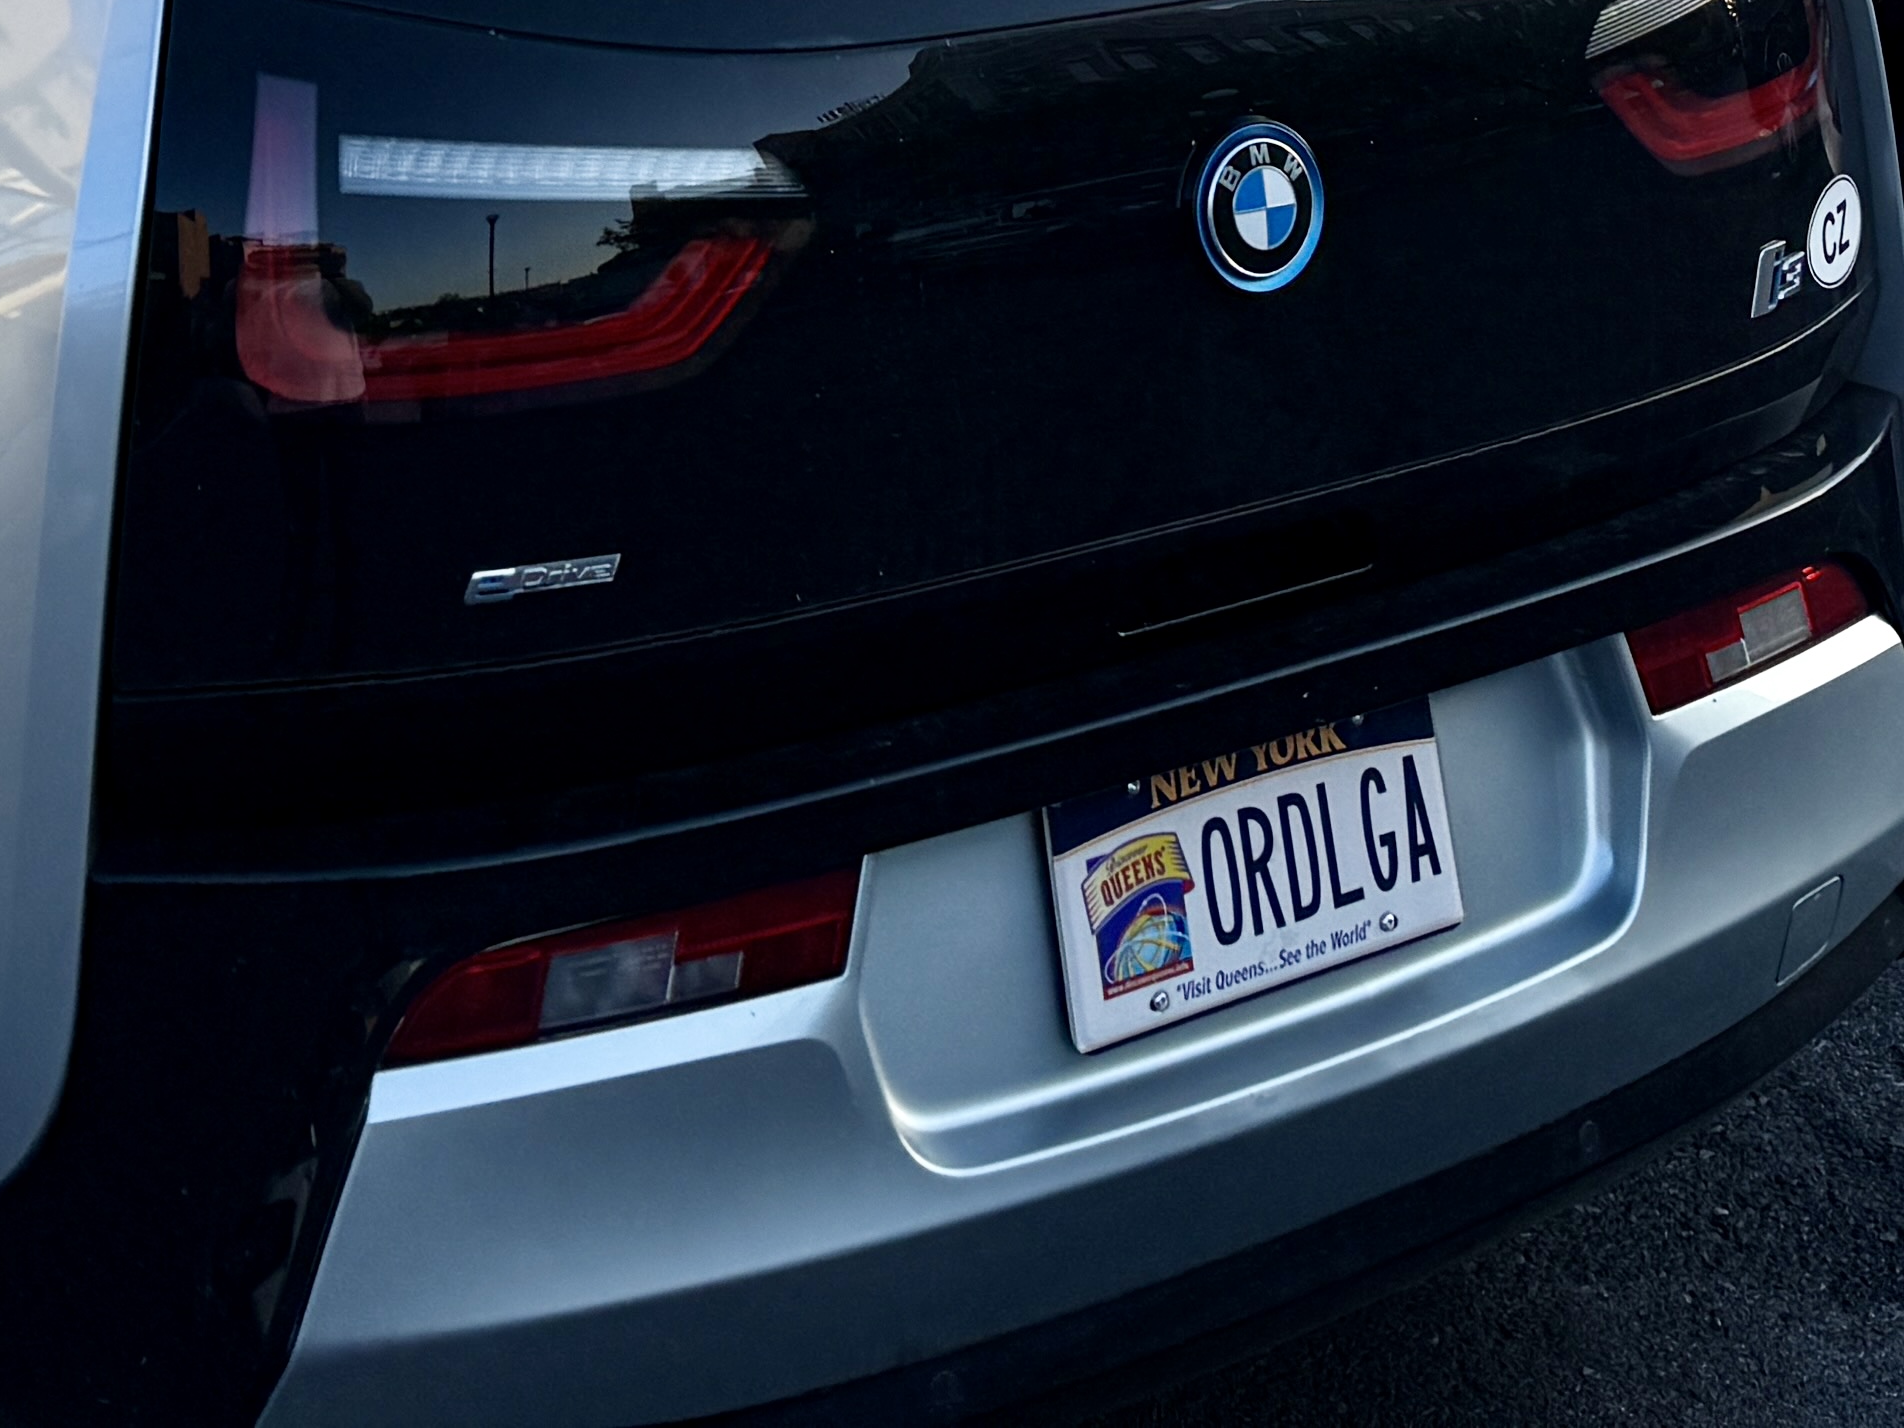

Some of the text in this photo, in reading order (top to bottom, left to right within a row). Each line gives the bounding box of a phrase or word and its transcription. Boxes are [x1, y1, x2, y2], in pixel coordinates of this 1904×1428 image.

[1219, 143, 1305, 192] BMW
[1822, 198, 1851, 265] CZ
[1149, 721, 1348, 810] NEW YORK
[1200, 754, 1443, 946] ORDLGA
[1304, 940, 1327, 962] the
